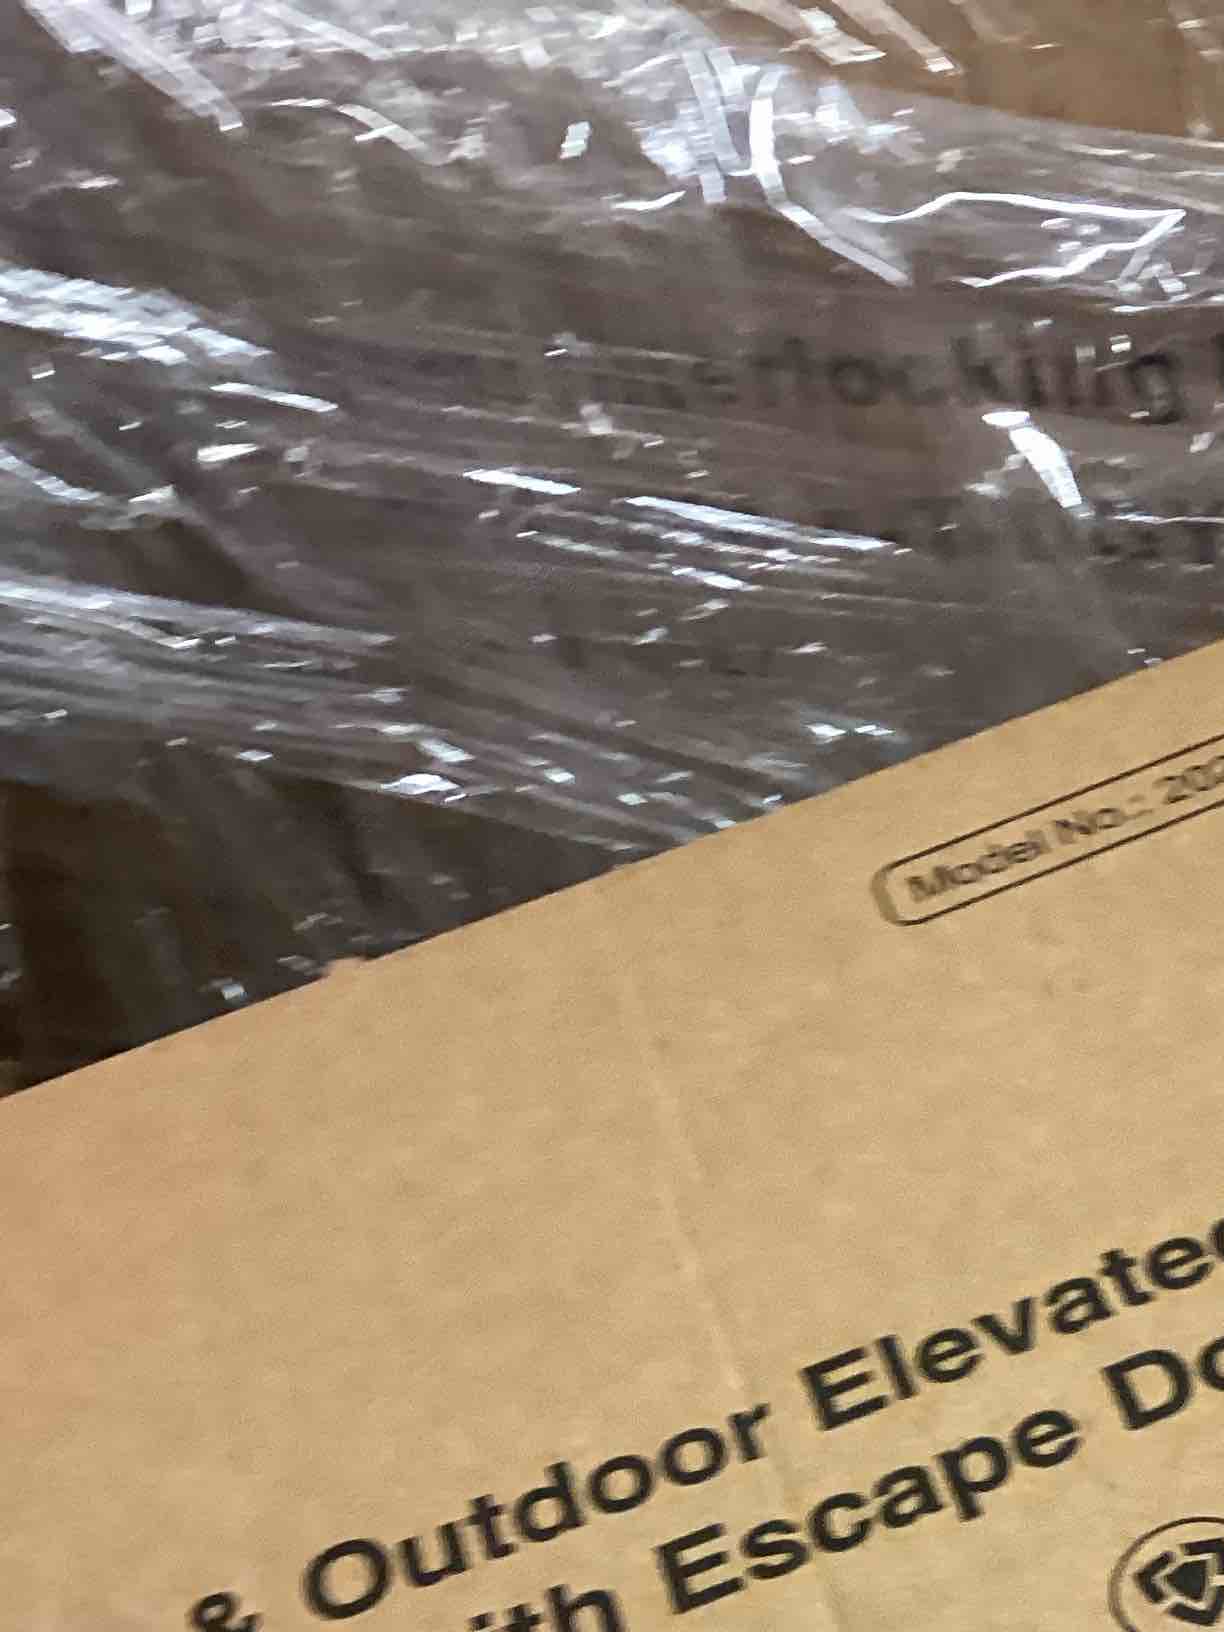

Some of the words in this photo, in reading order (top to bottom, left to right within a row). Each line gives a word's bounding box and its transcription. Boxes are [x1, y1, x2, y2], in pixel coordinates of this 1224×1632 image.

[905, 828, 1052, 902] Model
[303, 1403, 770, 1622] Outdoor
[654, 1407, 1082, 1614] Escape
